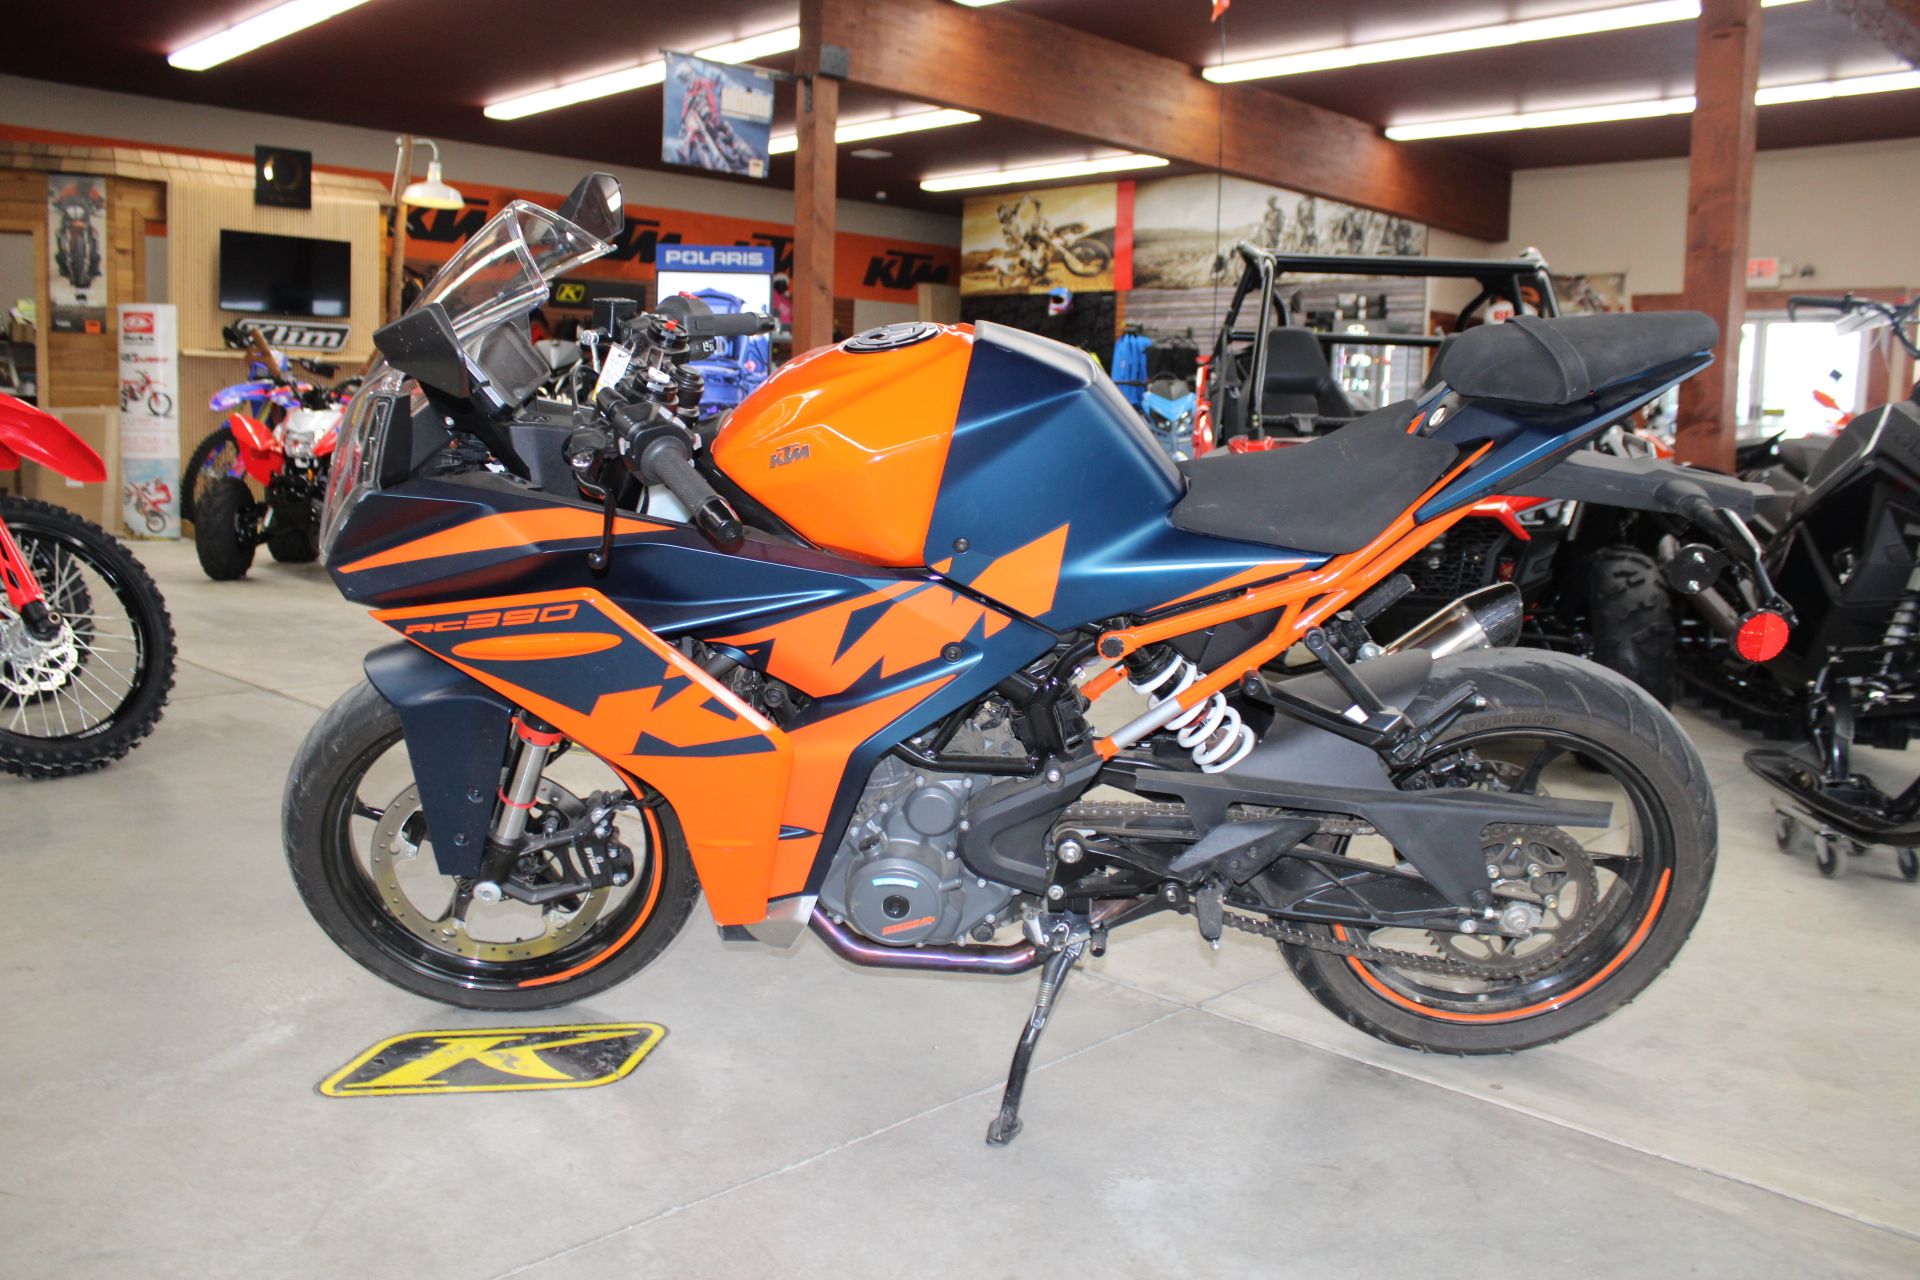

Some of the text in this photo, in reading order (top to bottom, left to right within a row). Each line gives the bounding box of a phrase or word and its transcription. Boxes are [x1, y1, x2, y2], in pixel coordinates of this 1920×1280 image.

[665, 250, 764, 267] POLARIS
[863, 249, 951, 289] KTM
[769, 442, 810, 469] KTM
